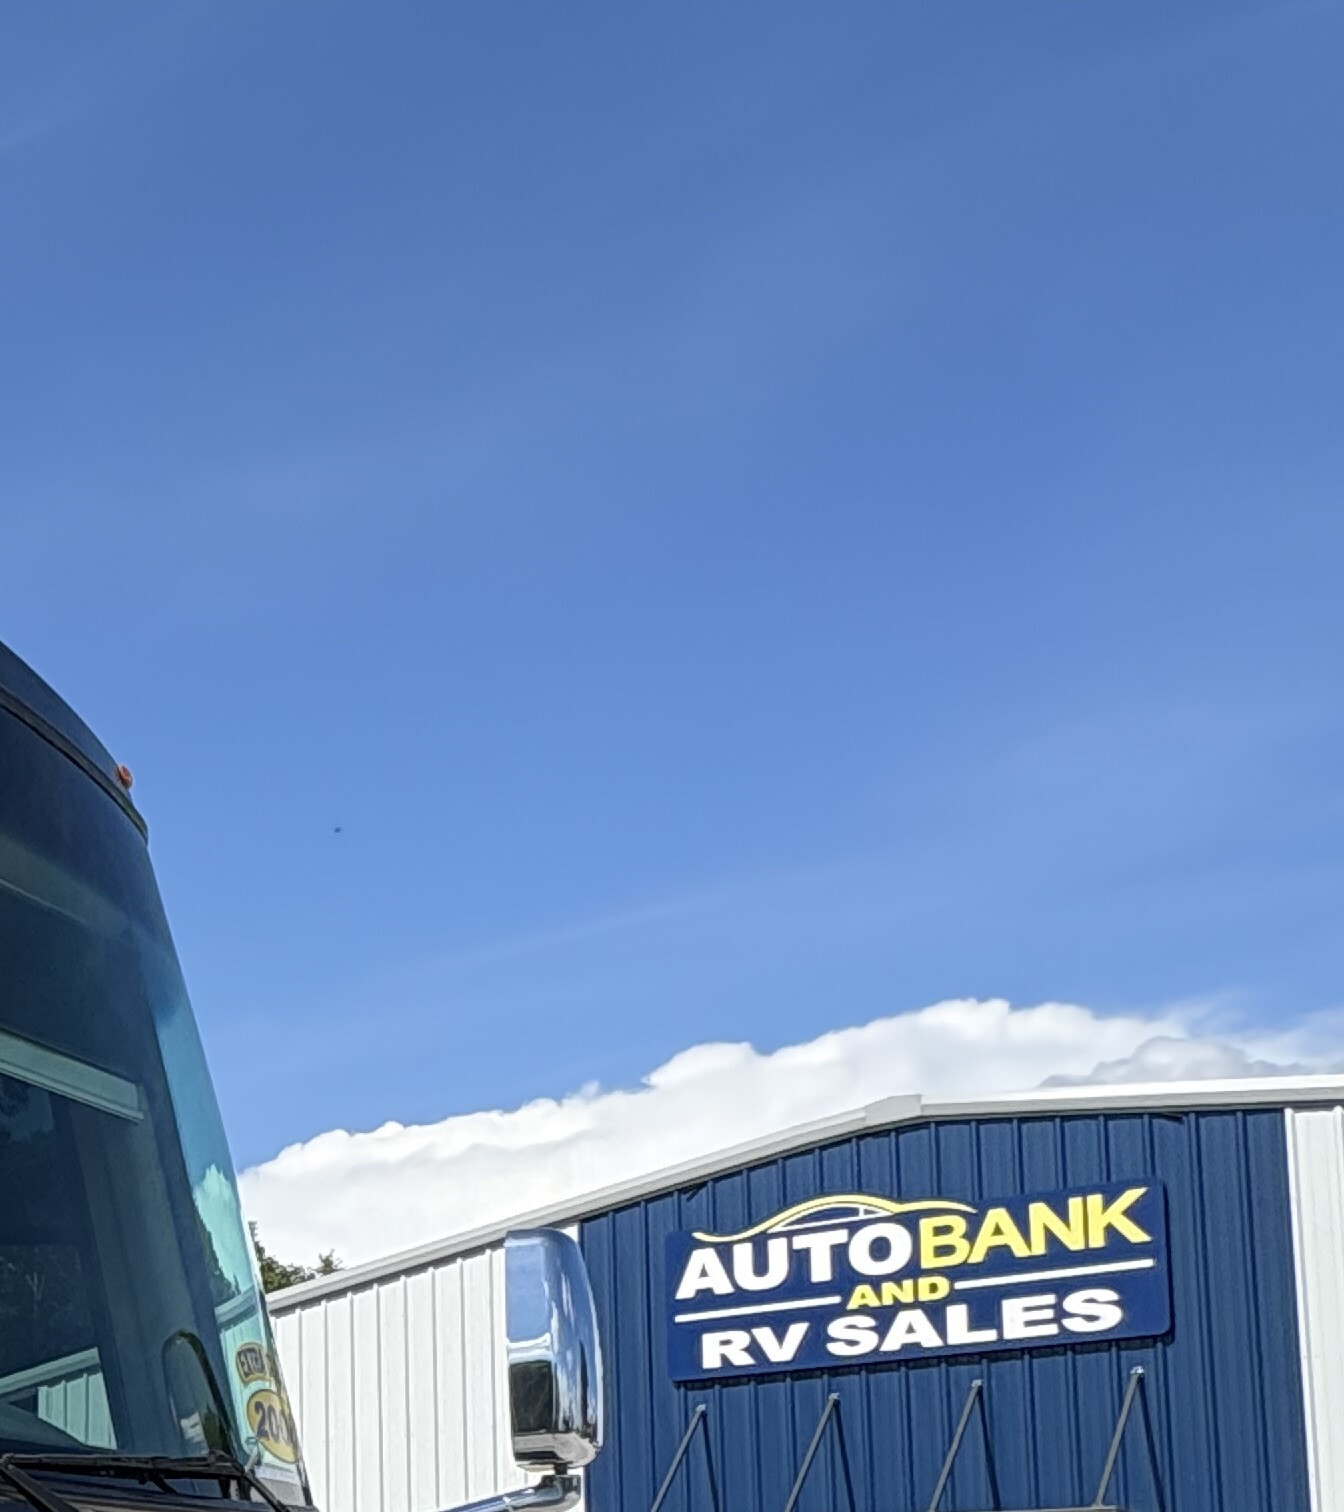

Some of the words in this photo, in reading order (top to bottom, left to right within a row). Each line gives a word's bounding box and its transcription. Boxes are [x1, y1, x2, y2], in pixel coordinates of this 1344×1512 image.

[674, 1186, 1152, 1300] AUTOBANK
[701, 1322, 810, 1370] RV
[826, 1288, 1123, 1357] SALES
[847, 1275, 950, 1310] AND
